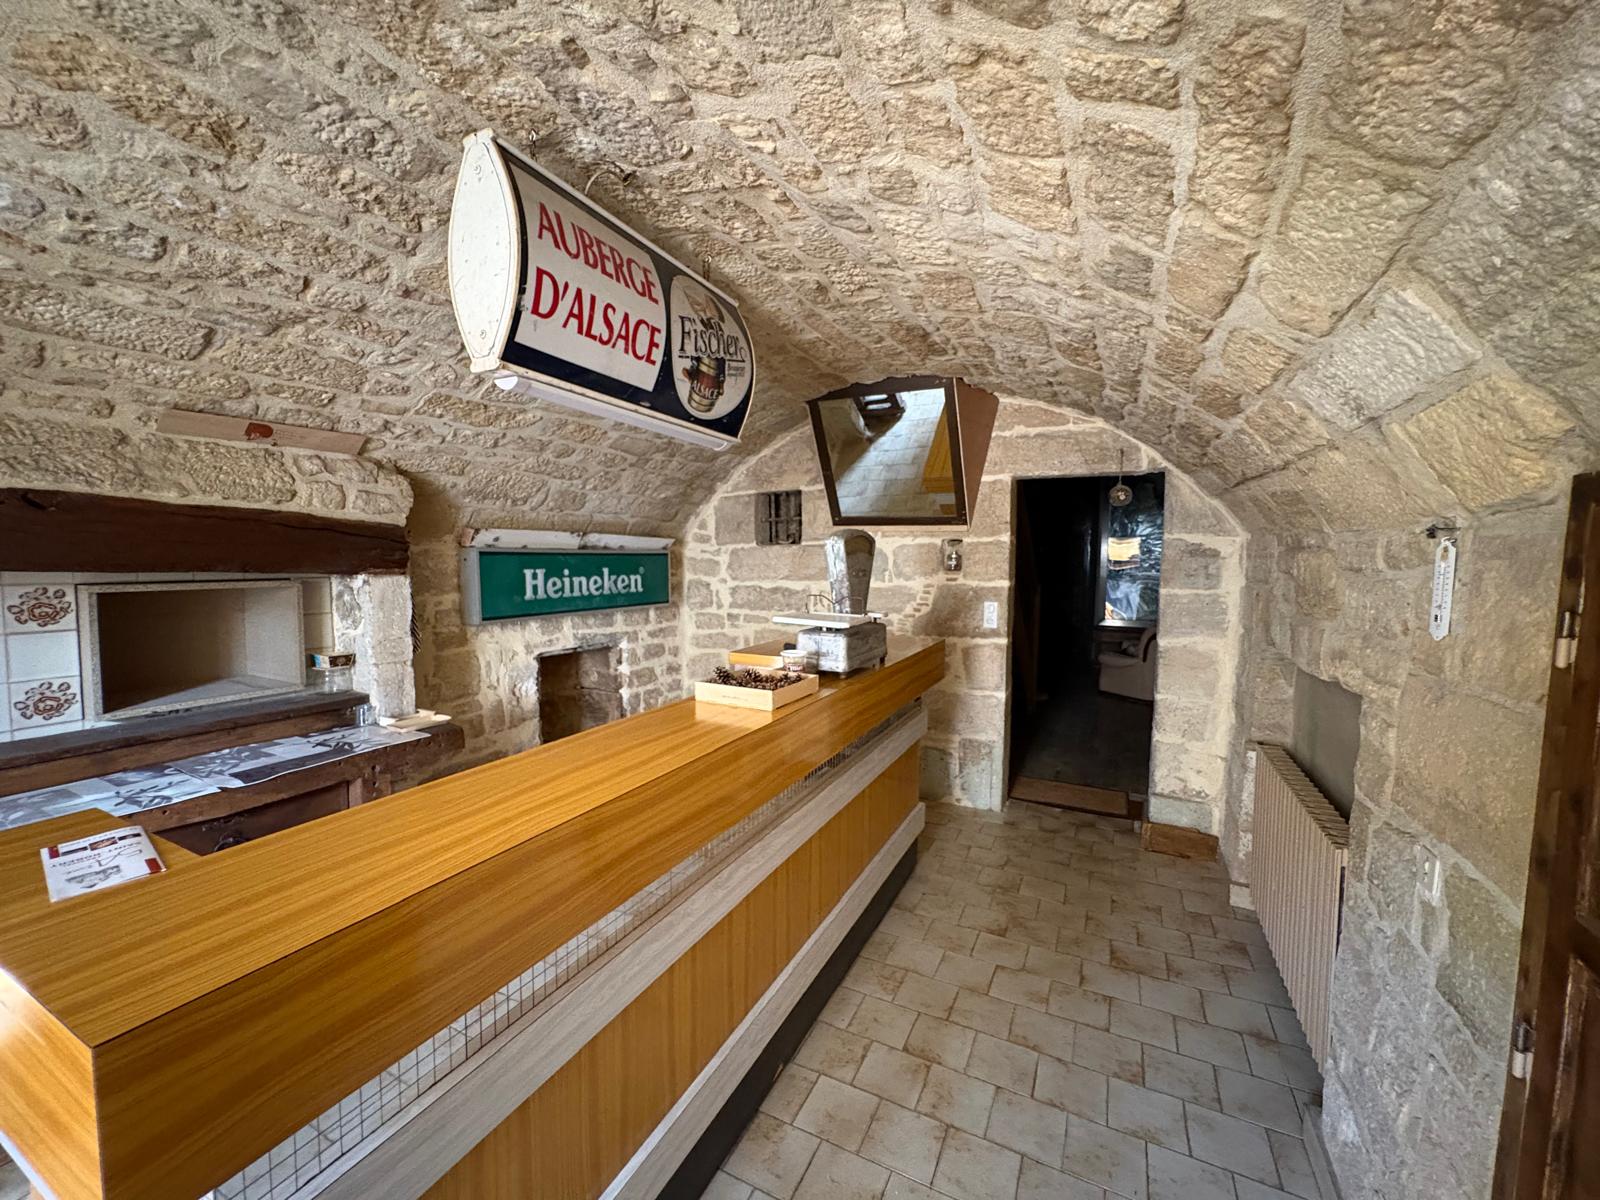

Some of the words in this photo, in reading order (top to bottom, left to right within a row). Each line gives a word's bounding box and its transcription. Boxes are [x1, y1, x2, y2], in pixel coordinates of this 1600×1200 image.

[537, 201, 659, 305] AUBERGE
[530, 266, 662, 366] D'ALSACE
[678, 315, 742, 359] Fischer
[691, 379, 719, 400] ALSACE
[523, 566, 644, 601] Heineken
